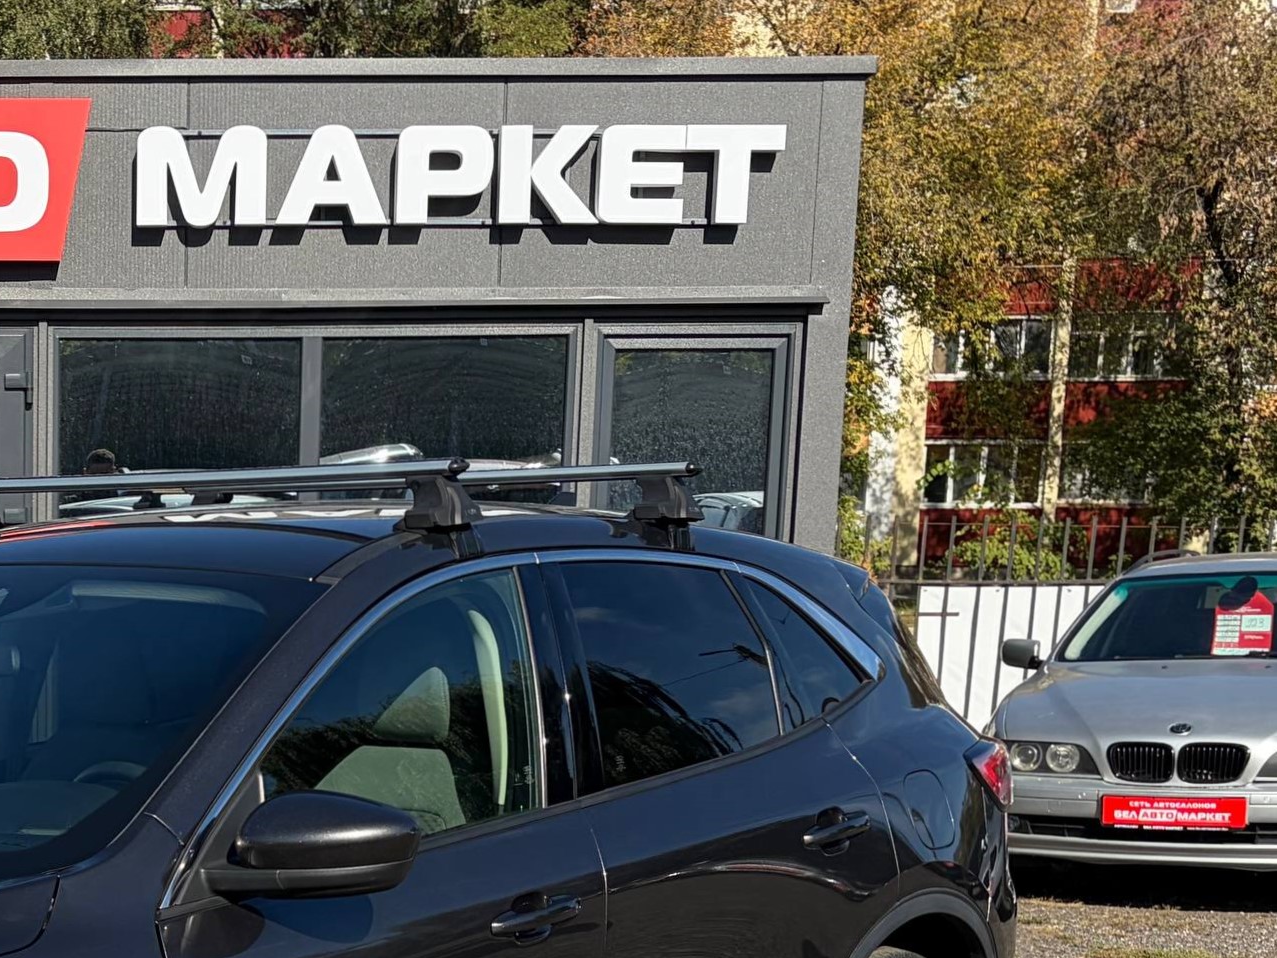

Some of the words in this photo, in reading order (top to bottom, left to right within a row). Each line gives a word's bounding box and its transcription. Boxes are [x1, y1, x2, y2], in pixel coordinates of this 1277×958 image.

[135, 123, 787, 228] МАРКЕТ
[1128, 800, 1151, 808] СЕТЬ
[1153, 801, 1217, 810] АВТОСАЛОНОВ
[1140, 810, 1175, 821] АВТО
[1177, 812, 1232, 822] МАРКЕТ
